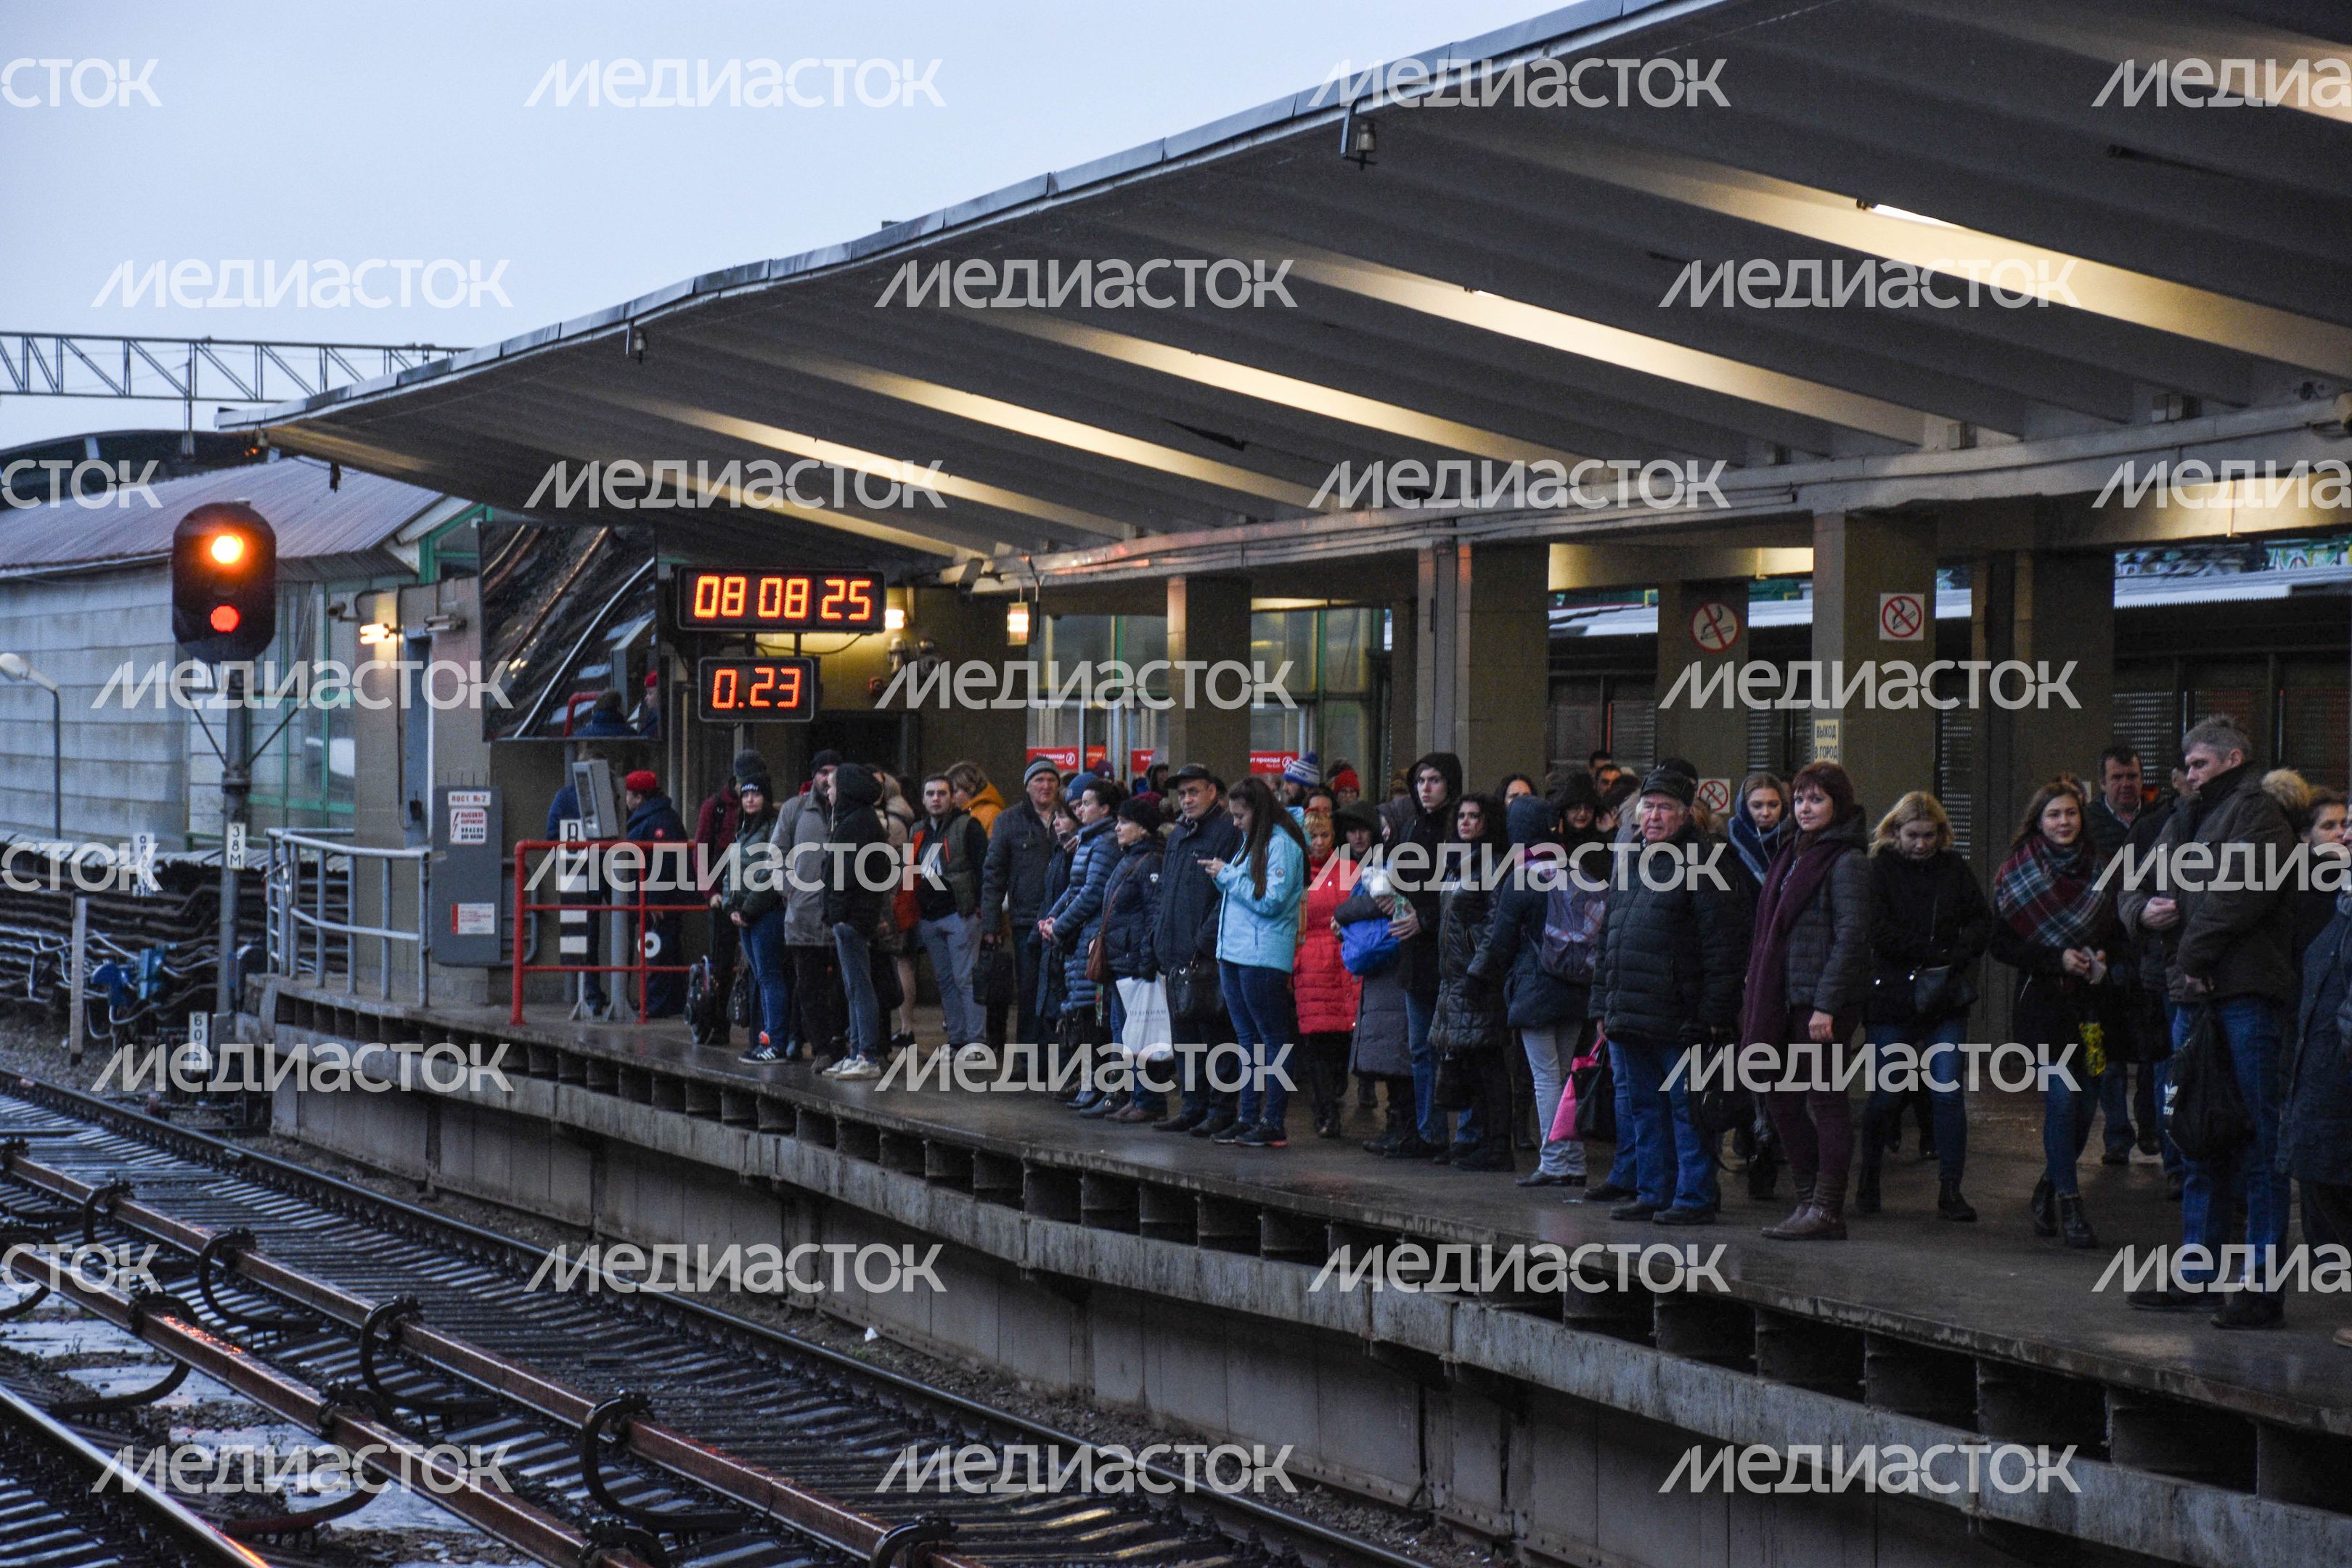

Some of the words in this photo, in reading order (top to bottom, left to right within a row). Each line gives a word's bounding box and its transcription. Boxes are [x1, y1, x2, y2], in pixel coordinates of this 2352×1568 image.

[694, 576, 746, 618] 08
[758, 577, 809, 618] 08
[821, 579, 870, 621] 25
[712, 667, 801, 709] 0.23
[1816, 725, 1836, 739] ВЫХОД
